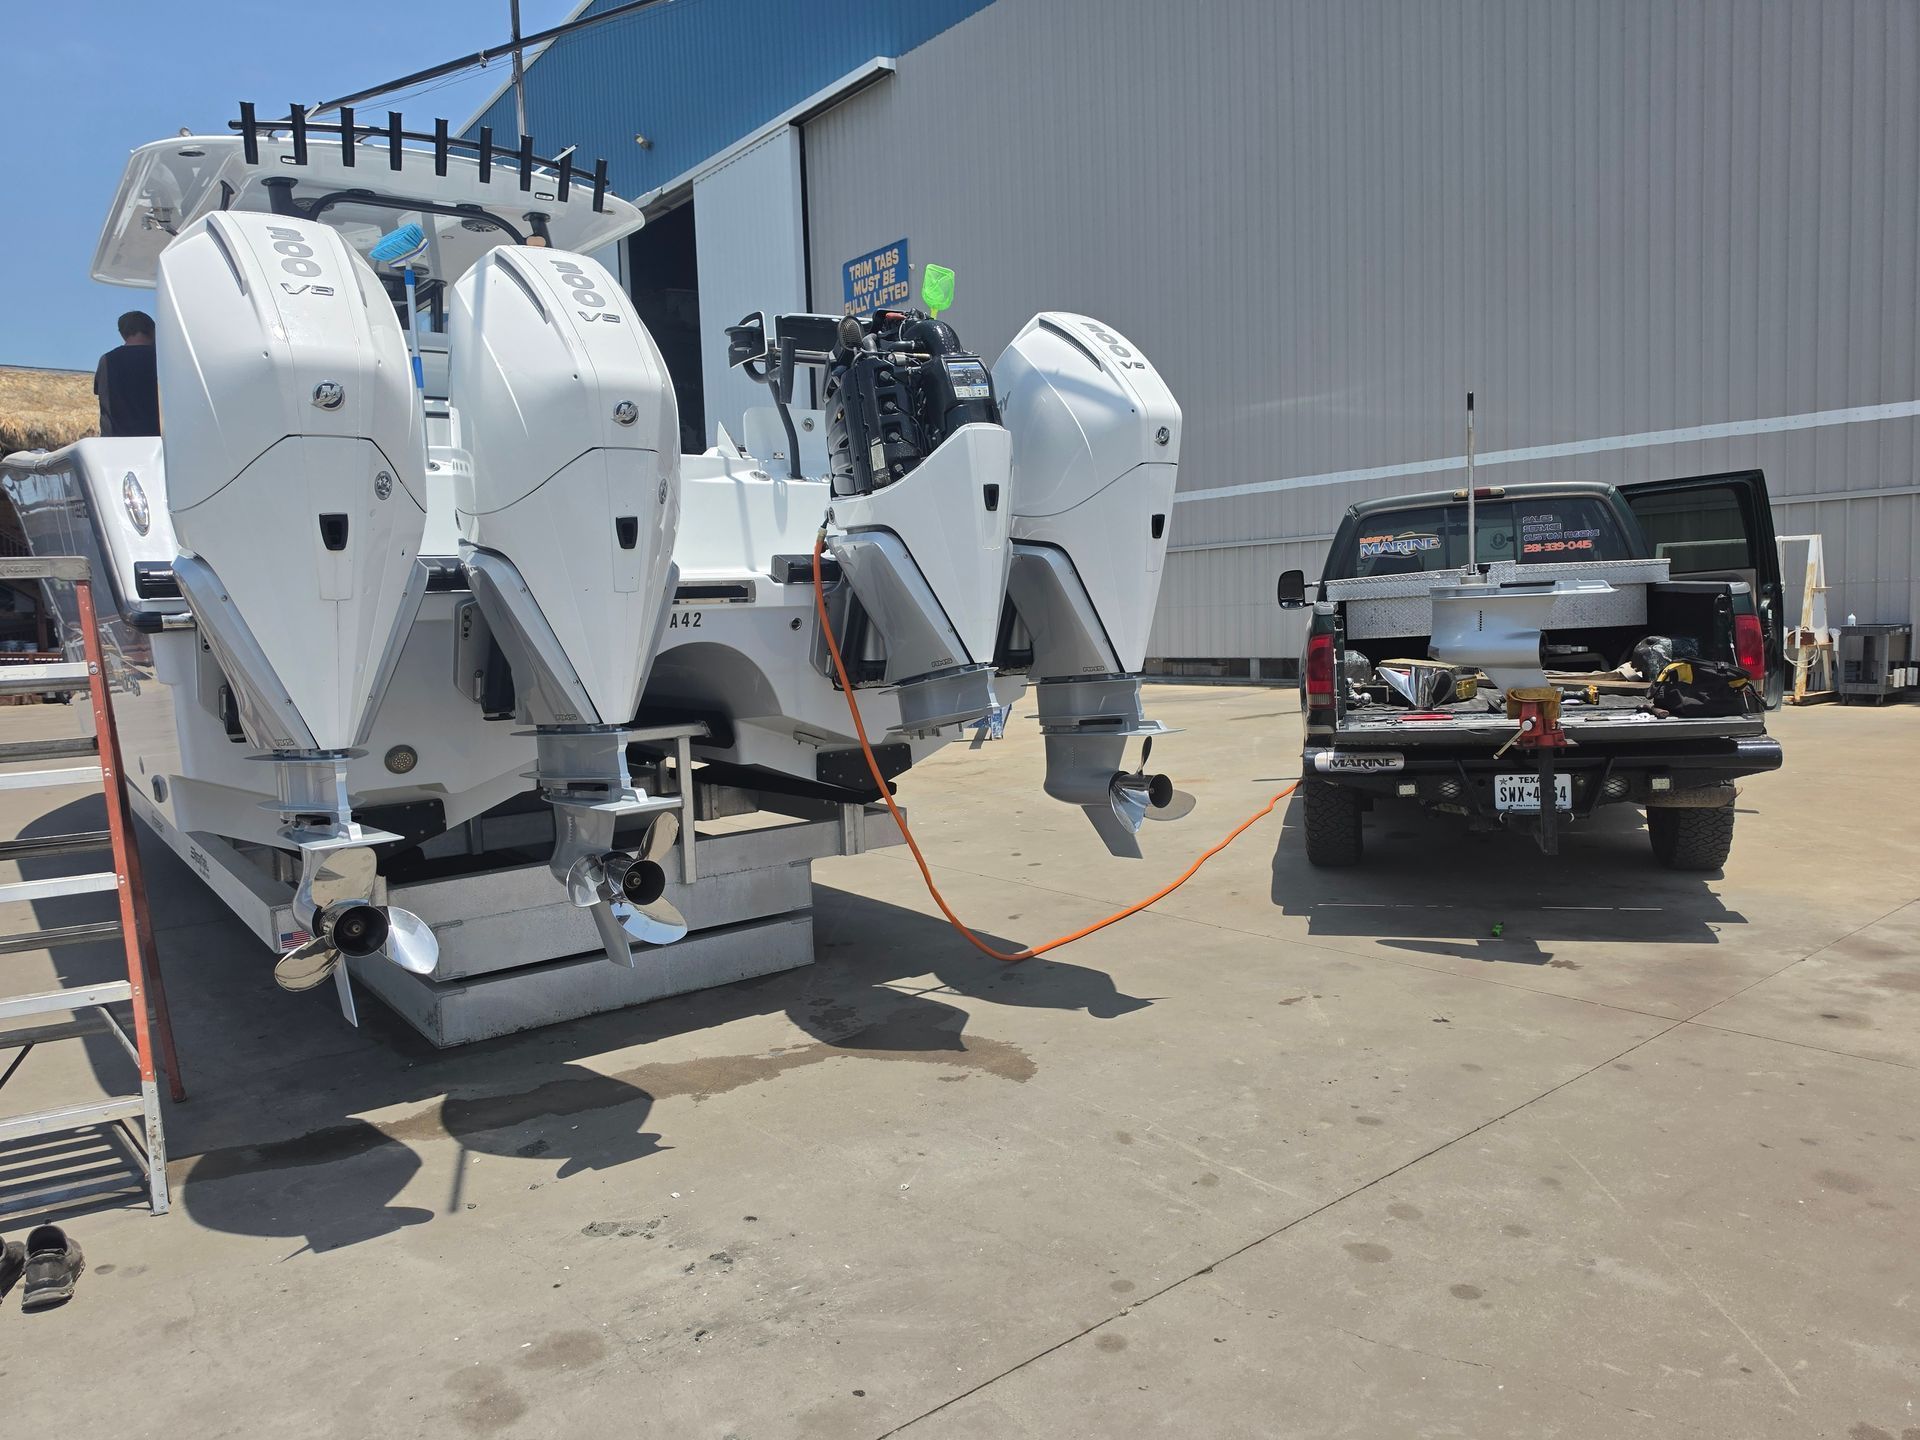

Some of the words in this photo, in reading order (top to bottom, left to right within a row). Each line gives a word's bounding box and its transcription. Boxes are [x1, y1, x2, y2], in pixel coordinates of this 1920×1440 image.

[266, 225, 322, 278] 300
[849, 258, 873, 281] TRIM
[874, 248, 899, 271] TABS
[280, 282, 335, 297] V8
[549, 259, 606, 307] 300
[853, 273, 880, 297] MUST
[882, 267, 896, 286] BE
[844, 293, 871, 316] FULLY
[873, 280, 909, 307] LIFTED
[577, 310, 621, 324] V8
[1522, 523, 1562, 533] SERVICE
[1523, 532, 1563, 542] CUSTOM
[1359, 537, 1441, 560] MARINE
[669, 611, 702, 629] A42
[1328, 758, 1398, 770] MARINE
